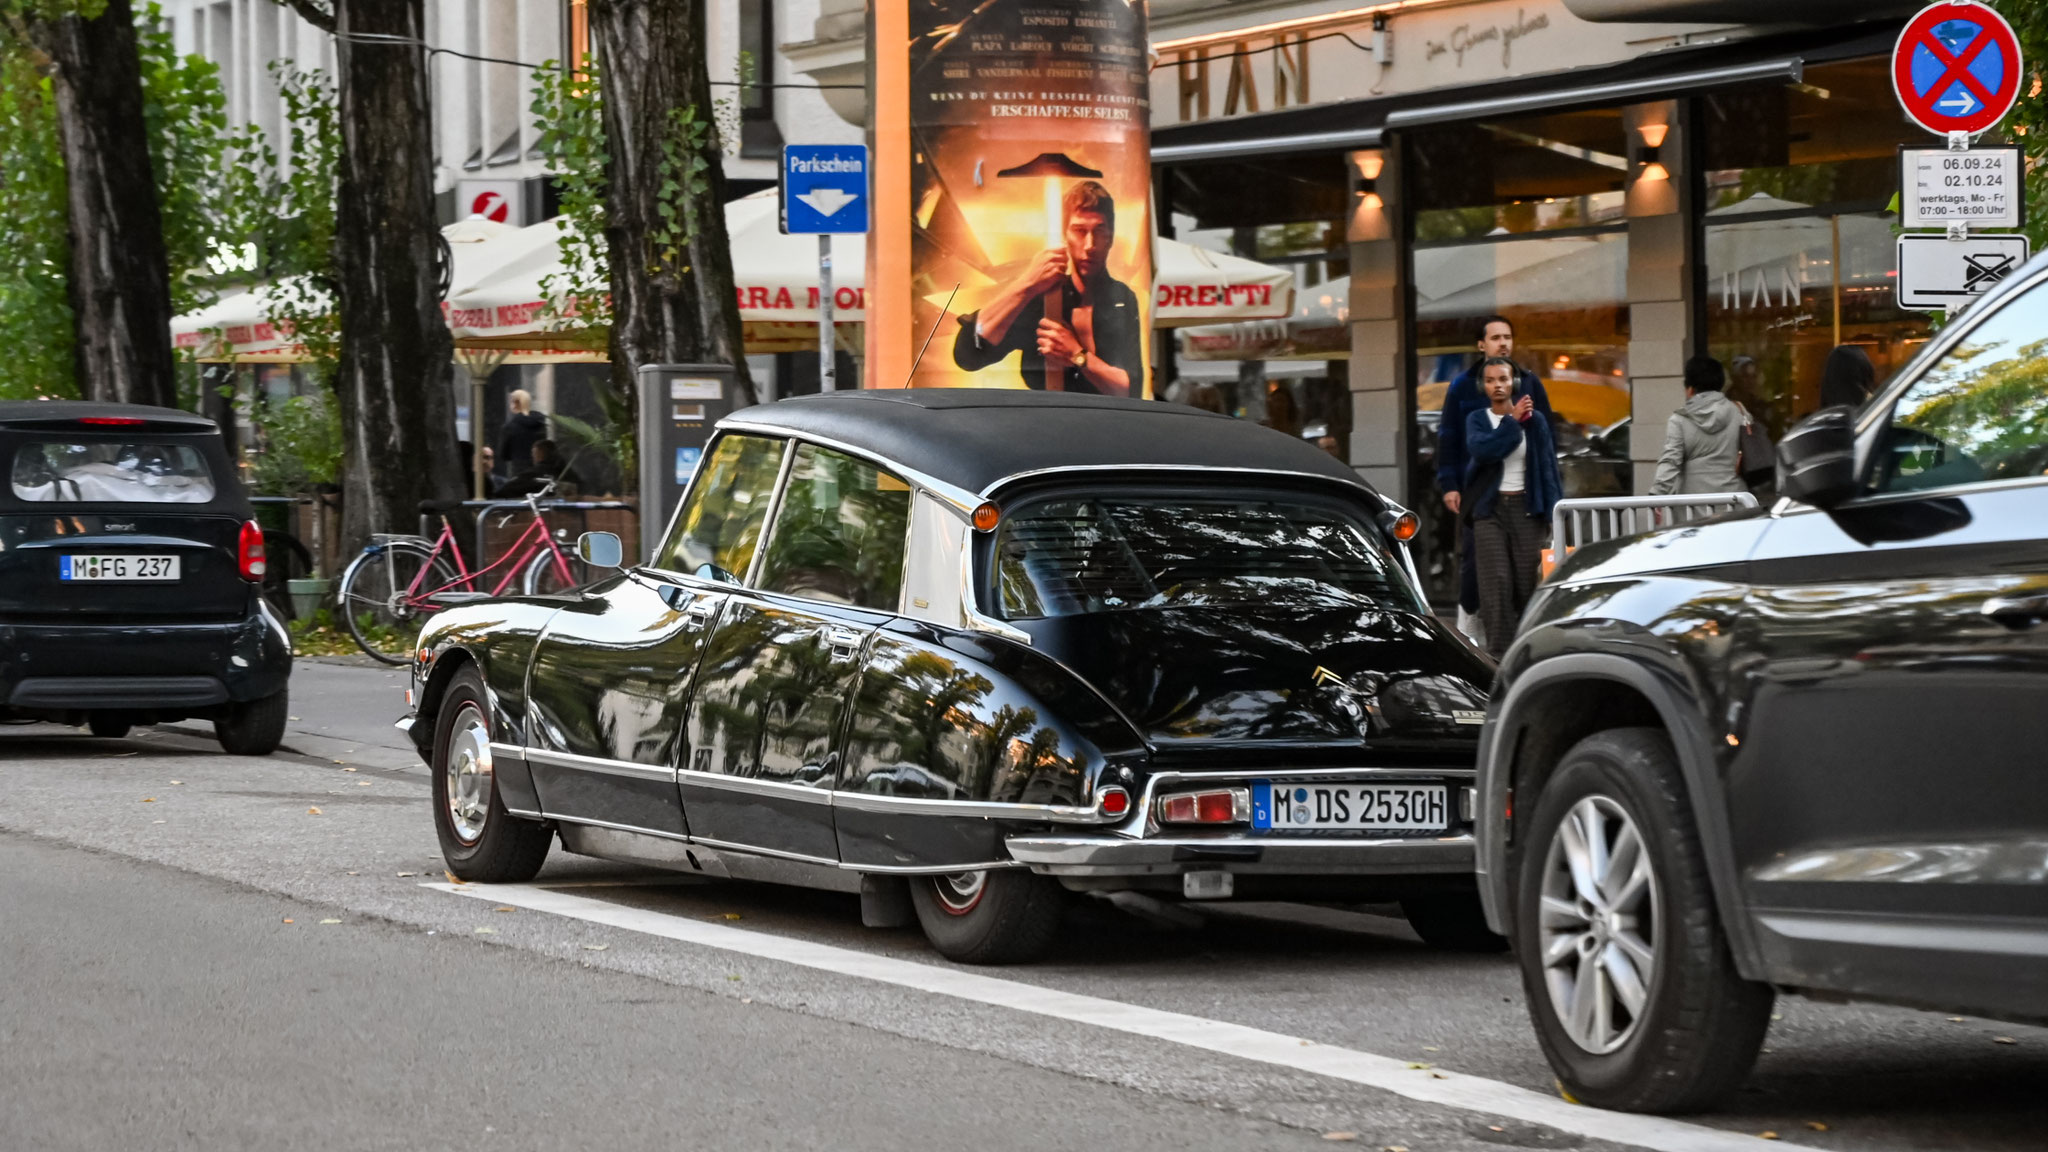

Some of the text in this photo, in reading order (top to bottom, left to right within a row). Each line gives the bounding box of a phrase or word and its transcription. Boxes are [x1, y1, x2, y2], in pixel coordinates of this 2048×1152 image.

[1178, 30, 1310, 121] HAN
[969, 92, 987, 100] DU
[993, 92, 1034, 100] KEINE
[1041, 92, 1091, 102] BESSERE
[991, 105, 1070, 118] ERSCHAFFE
[1073, 106, 1092, 118] SIE
[790, 156, 862, 173] Parkschein
[1943, 158, 2002, 170] 06.09.24
[1944, 175, 2003, 187] 02.10.24
[1920, 193, 1968, 204] werktags,
[1971, 194, 1985, 202] Mo
[1994, 194, 2005, 202] Fr
[1920, 206, 1947, 215] 07:00
[1957, 206, 1984, 215] 18:00
[1987, 206, 2006, 215] Uhr
[1722, 266, 1801, 310] HAN
[105, 522, 136, 532] smart
[74, 558, 172, 577] M FG 237
[1274, 789, 1444, 824] M DS 2530H
[1258, 810, 1266, 821] D
